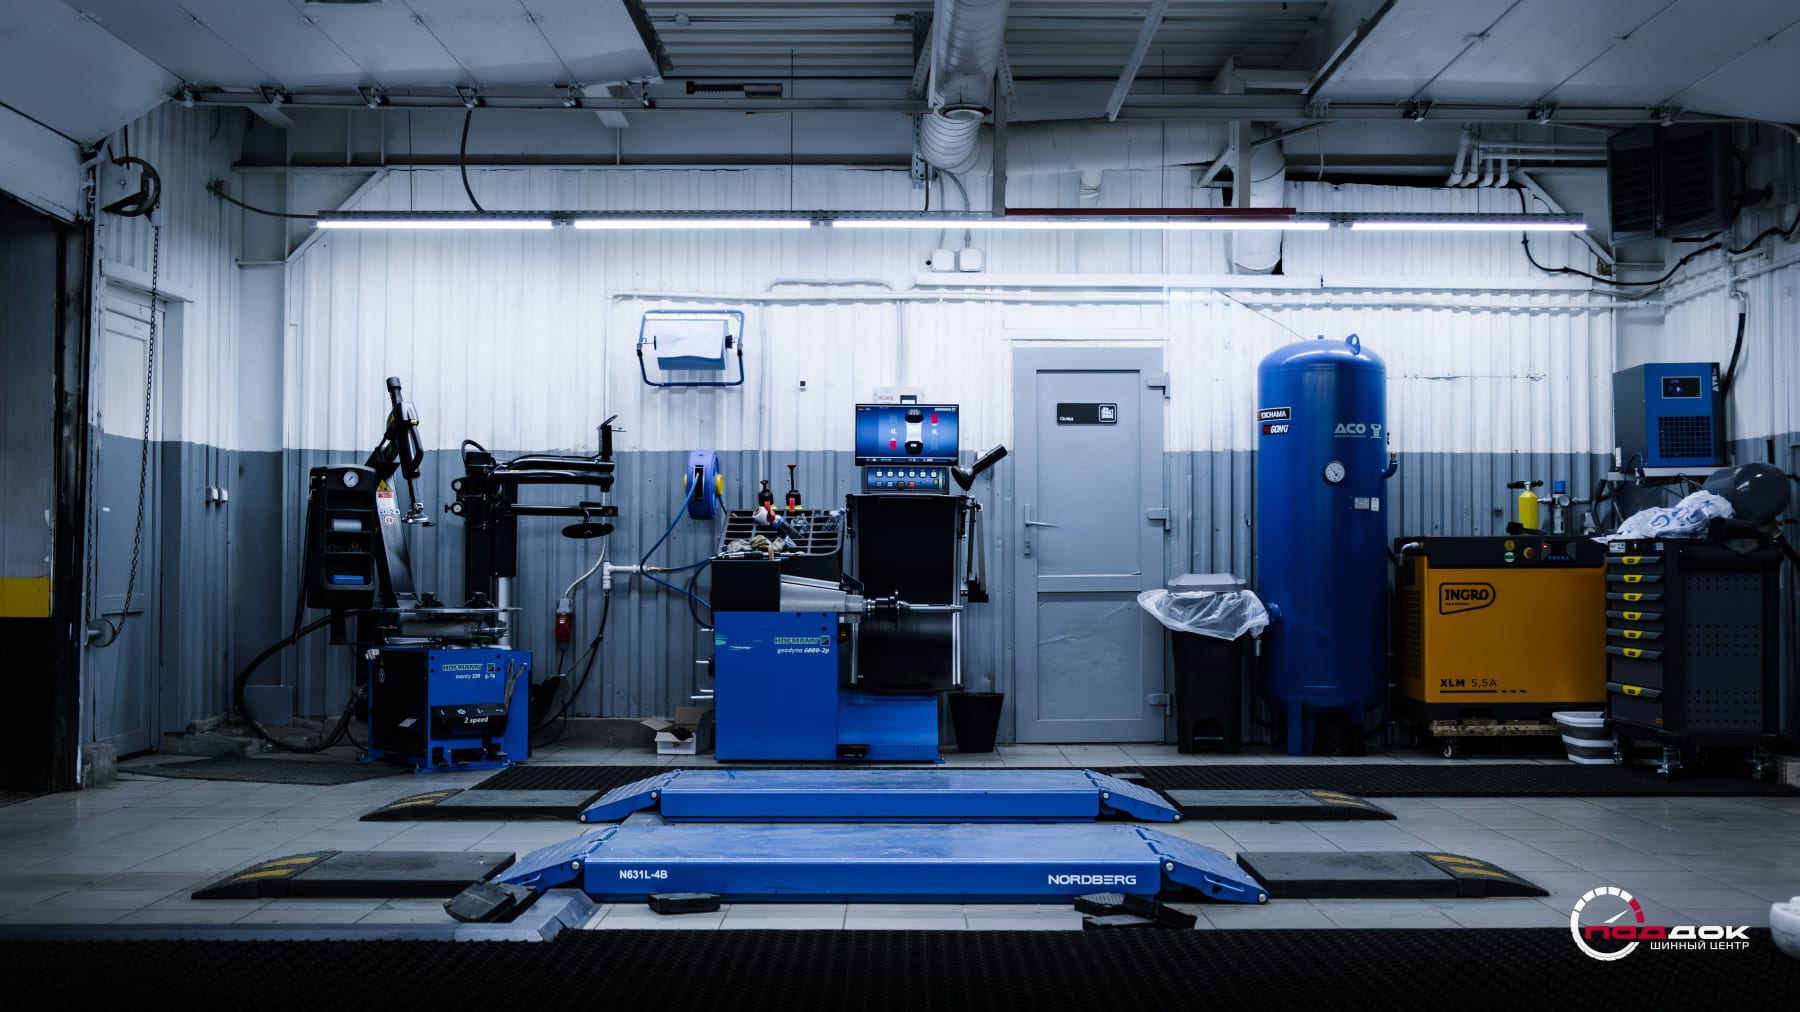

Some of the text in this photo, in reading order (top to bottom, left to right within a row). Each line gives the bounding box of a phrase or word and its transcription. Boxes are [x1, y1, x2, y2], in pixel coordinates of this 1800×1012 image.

[1334, 423, 1366, 434] ACO
[1445, 589, 1489, 600] INGRO
[1440, 678, 1497, 688] XLM 5,5A
[470, 716, 489, 724] speed
[619, 869, 668, 879] N631L-4B
[1048, 874, 1136, 885] NORDBERG
